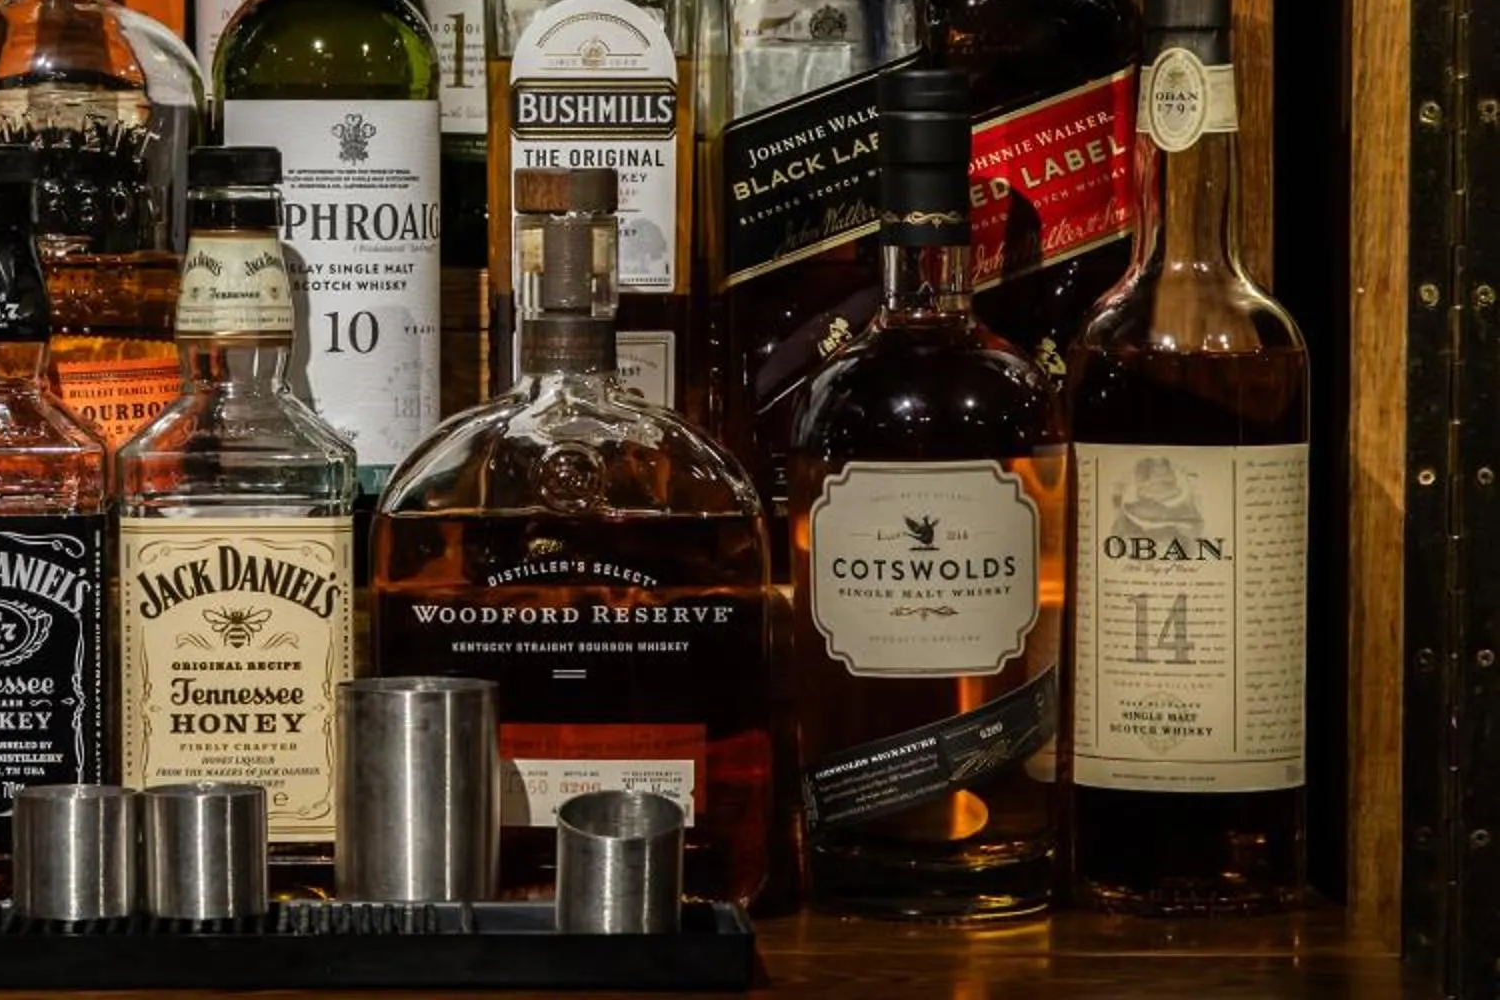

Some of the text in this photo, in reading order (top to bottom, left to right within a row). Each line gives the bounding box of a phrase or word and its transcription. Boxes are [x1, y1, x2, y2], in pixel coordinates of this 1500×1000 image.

[1155, 91, 1199, 101] OBAN
[517, 93, 673, 124] BUSHMILLS
[748, 105, 880, 169] JOHNNIE WALK
[967, 111, 1110, 176] OHNNIE WALKER
[523, 148, 665, 168] THE ORIGINAL
[733, 152, 827, 201] BLACK
[968, 136, 1127, 208] ED LABEL
[284, 203, 439, 241] PHROAIG
[289, 263, 415, 275] SLAY SINGLE MALT
[293, 281, 408, 291] SCOTCH WHISKY
[323, 310, 380, 354] 10
[82, 401, 162, 421] OURBO
[1103, 535, 1225, 561] OBAN
[487, 560, 654, 588] DISTILLER'S SELECT
[832, 556, 1016, 581] COTSWOLDS
[136, 545, 342, 620] JACK DANIEL'S
[837, 586, 1011, 599] SINGLE MALT WHISKY
[411, 605, 729, 625] WOODFORD RESERVE
[1127, 591, 1197, 665] 14
[451, 641, 690, 653] KENTUCKY STRAIGHT BOURBON WHISKEY
[171, 661, 303, 671] ORIGINAL RECIPE
[170, 677, 304, 707] Tennessee
[169, 713, 307, 734] HONEY
[1122, 711, 1198, 722] SINGLE MALT
[1109, 722, 1213, 737] SCOTCH WHISKY
[39, 741, 53, 749] BY
[179, 743, 298, 751] FINELY CRAFTED
[23, 767, 45, 775] USA
[155, 767, 183, 777] FROM
[185, 767, 201, 777] THE
[206, 767, 243, 777] MAKERS
[245, 767, 257, 777] OF
